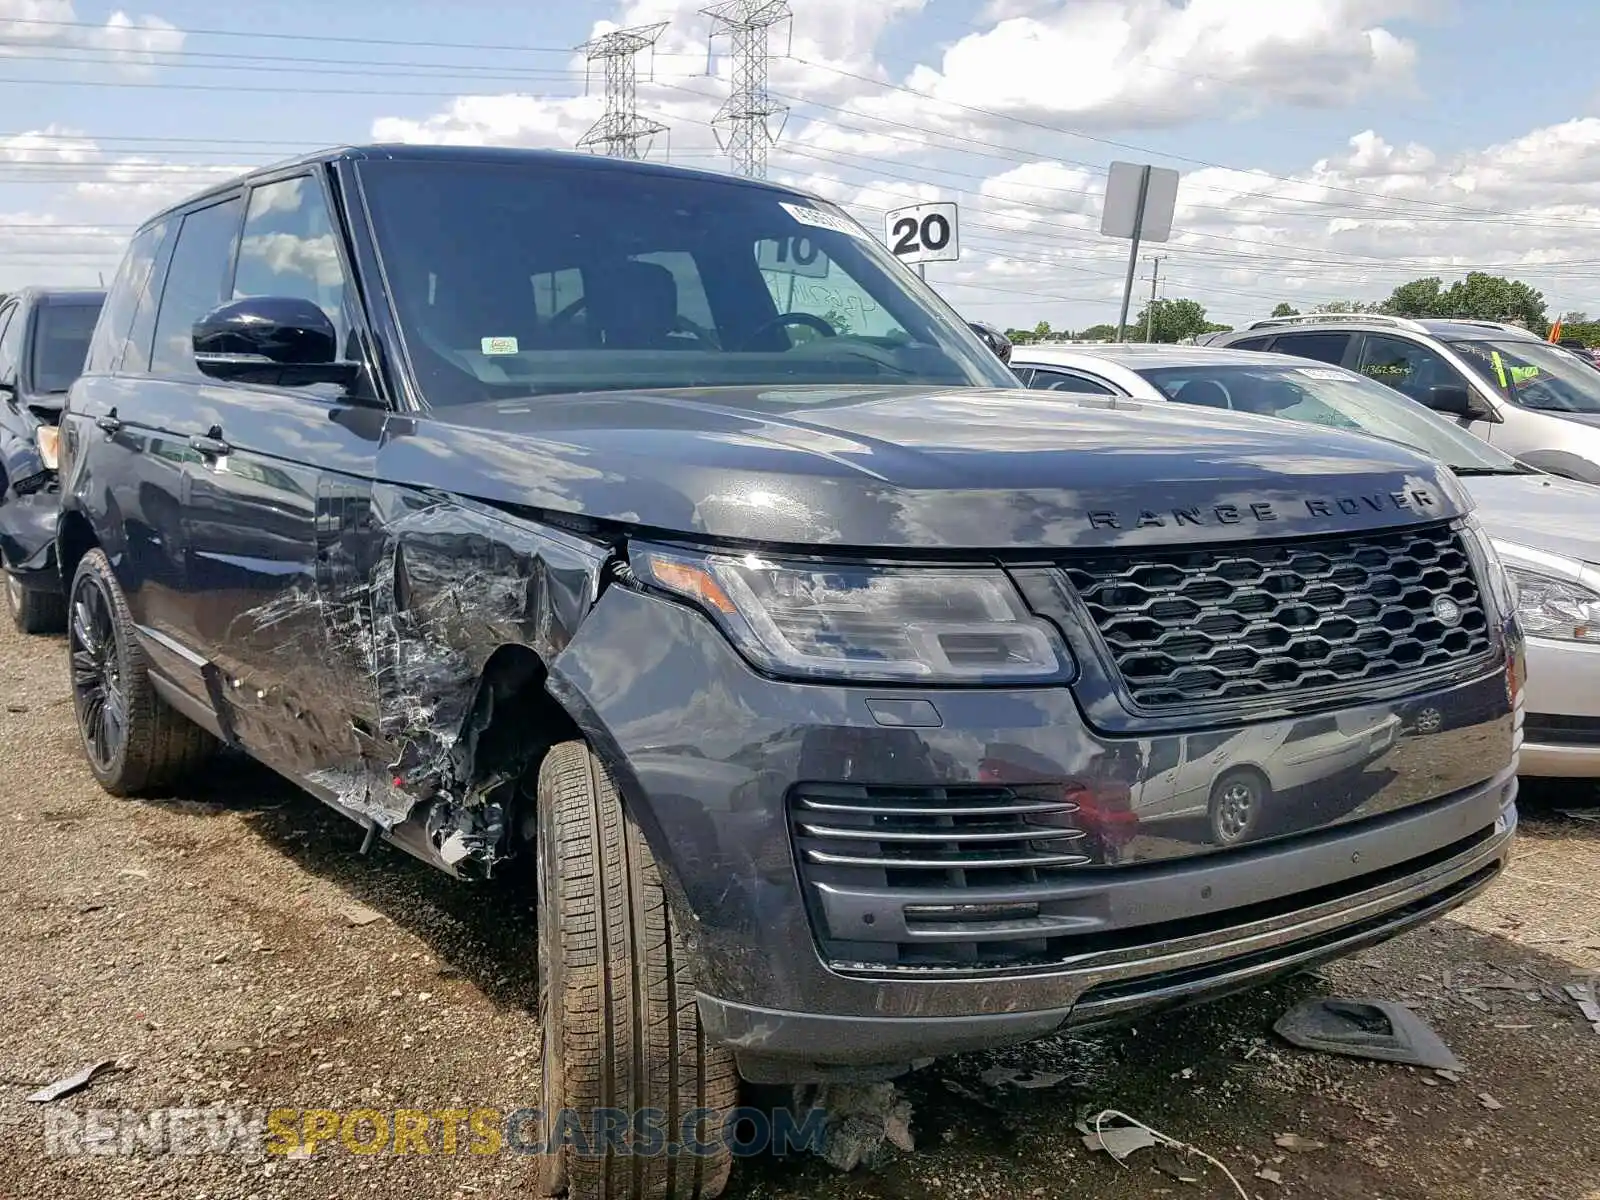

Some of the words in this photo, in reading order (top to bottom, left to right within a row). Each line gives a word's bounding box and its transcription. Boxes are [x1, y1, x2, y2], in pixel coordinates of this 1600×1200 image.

[773, 236, 819, 265] 10
[892, 213, 950, 255] 20
[1086, 501, 1279, 529] RANGE
[1304, 489, 1434, 518] ROVER
